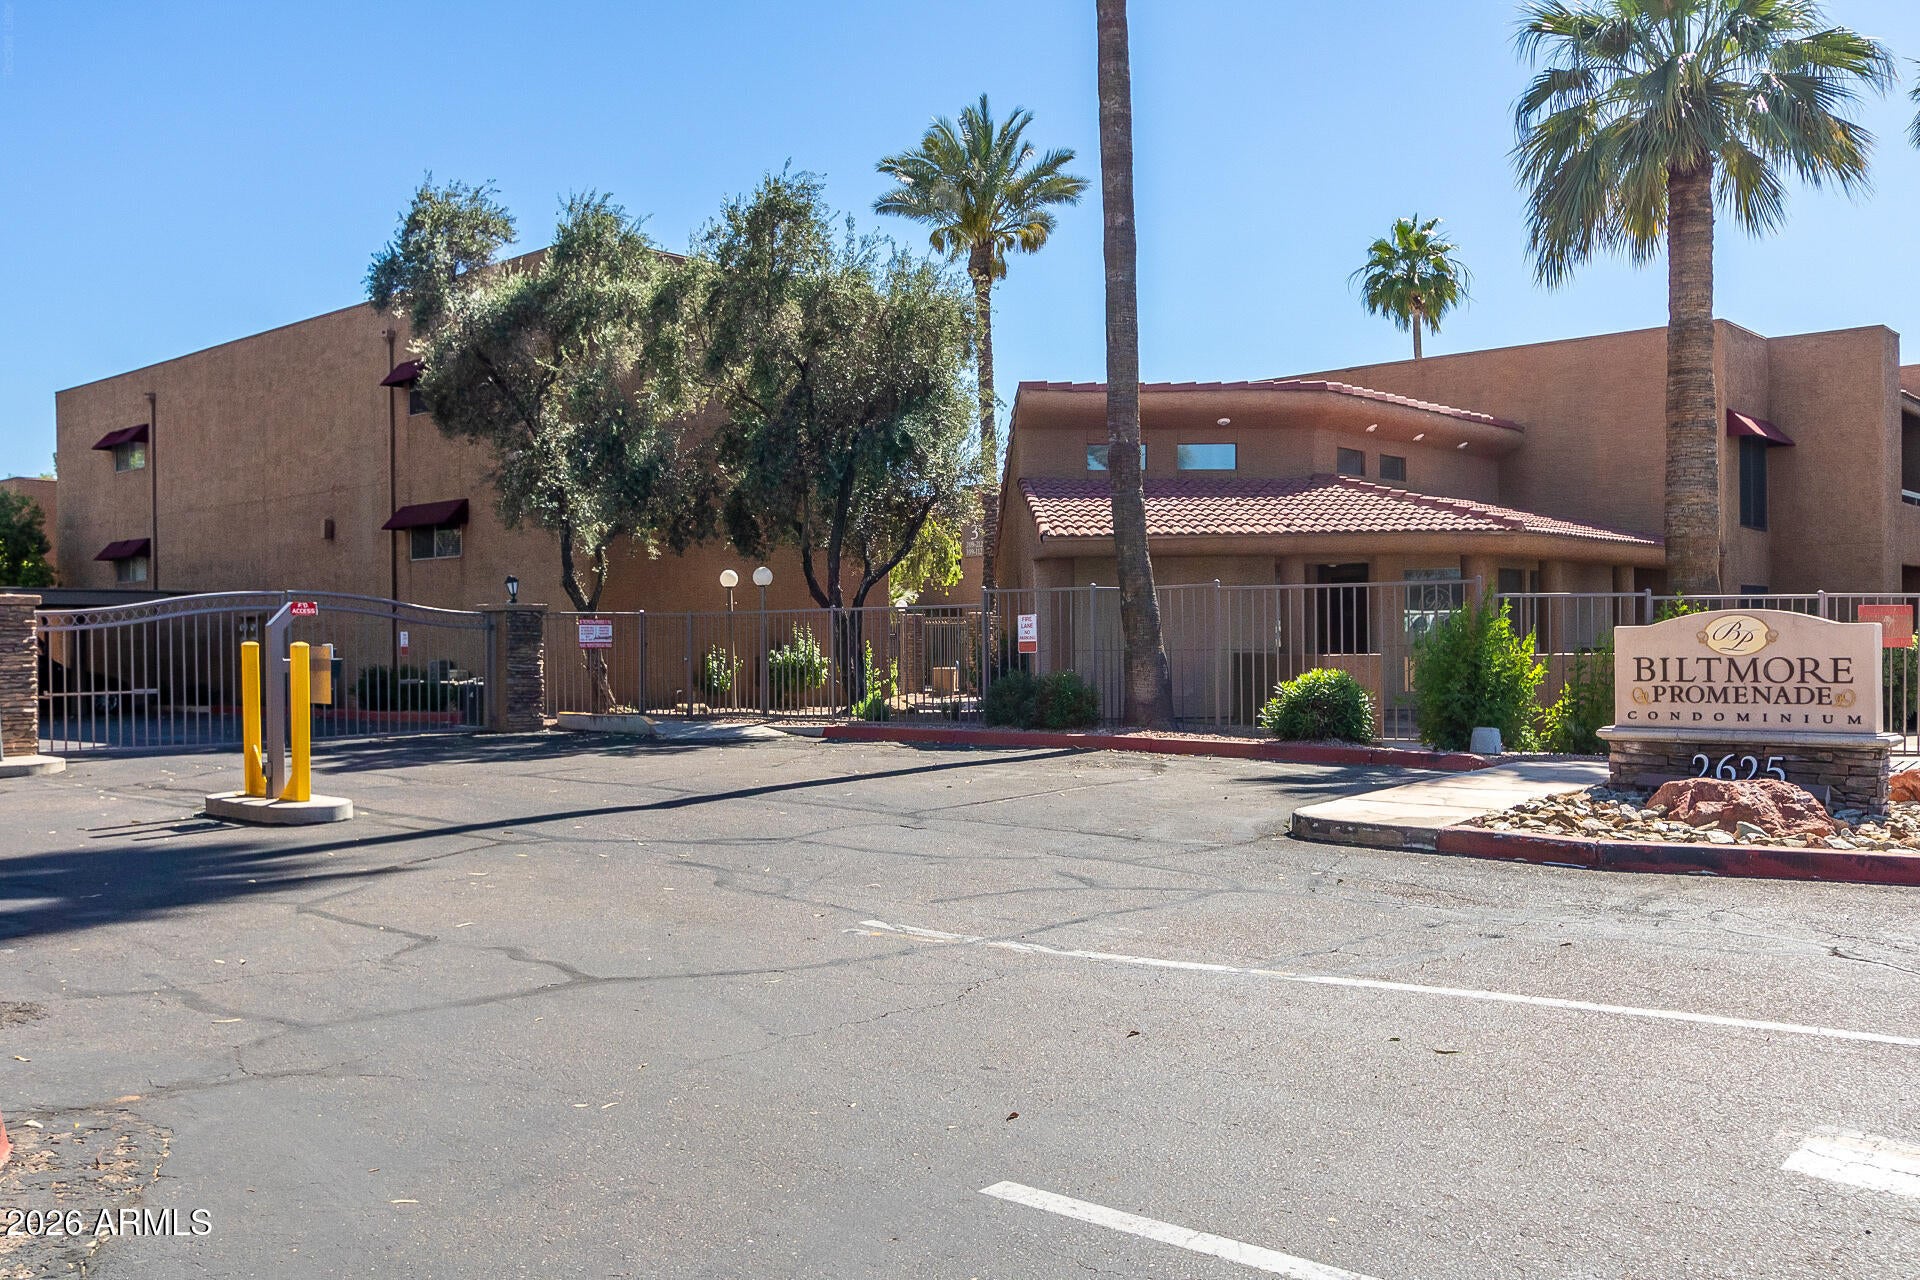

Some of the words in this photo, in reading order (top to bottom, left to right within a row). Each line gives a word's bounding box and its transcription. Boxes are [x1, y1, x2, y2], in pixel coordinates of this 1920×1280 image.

[970, 524, 978, 540] 3
[1632, 656, 1855, 684] BILTMORE
[1651, 685, 1833, 706] PROMENADE
[1627, 710, 1863, 725] CONDOMINIUM
[1692, 753, 1787, 781] 2625
